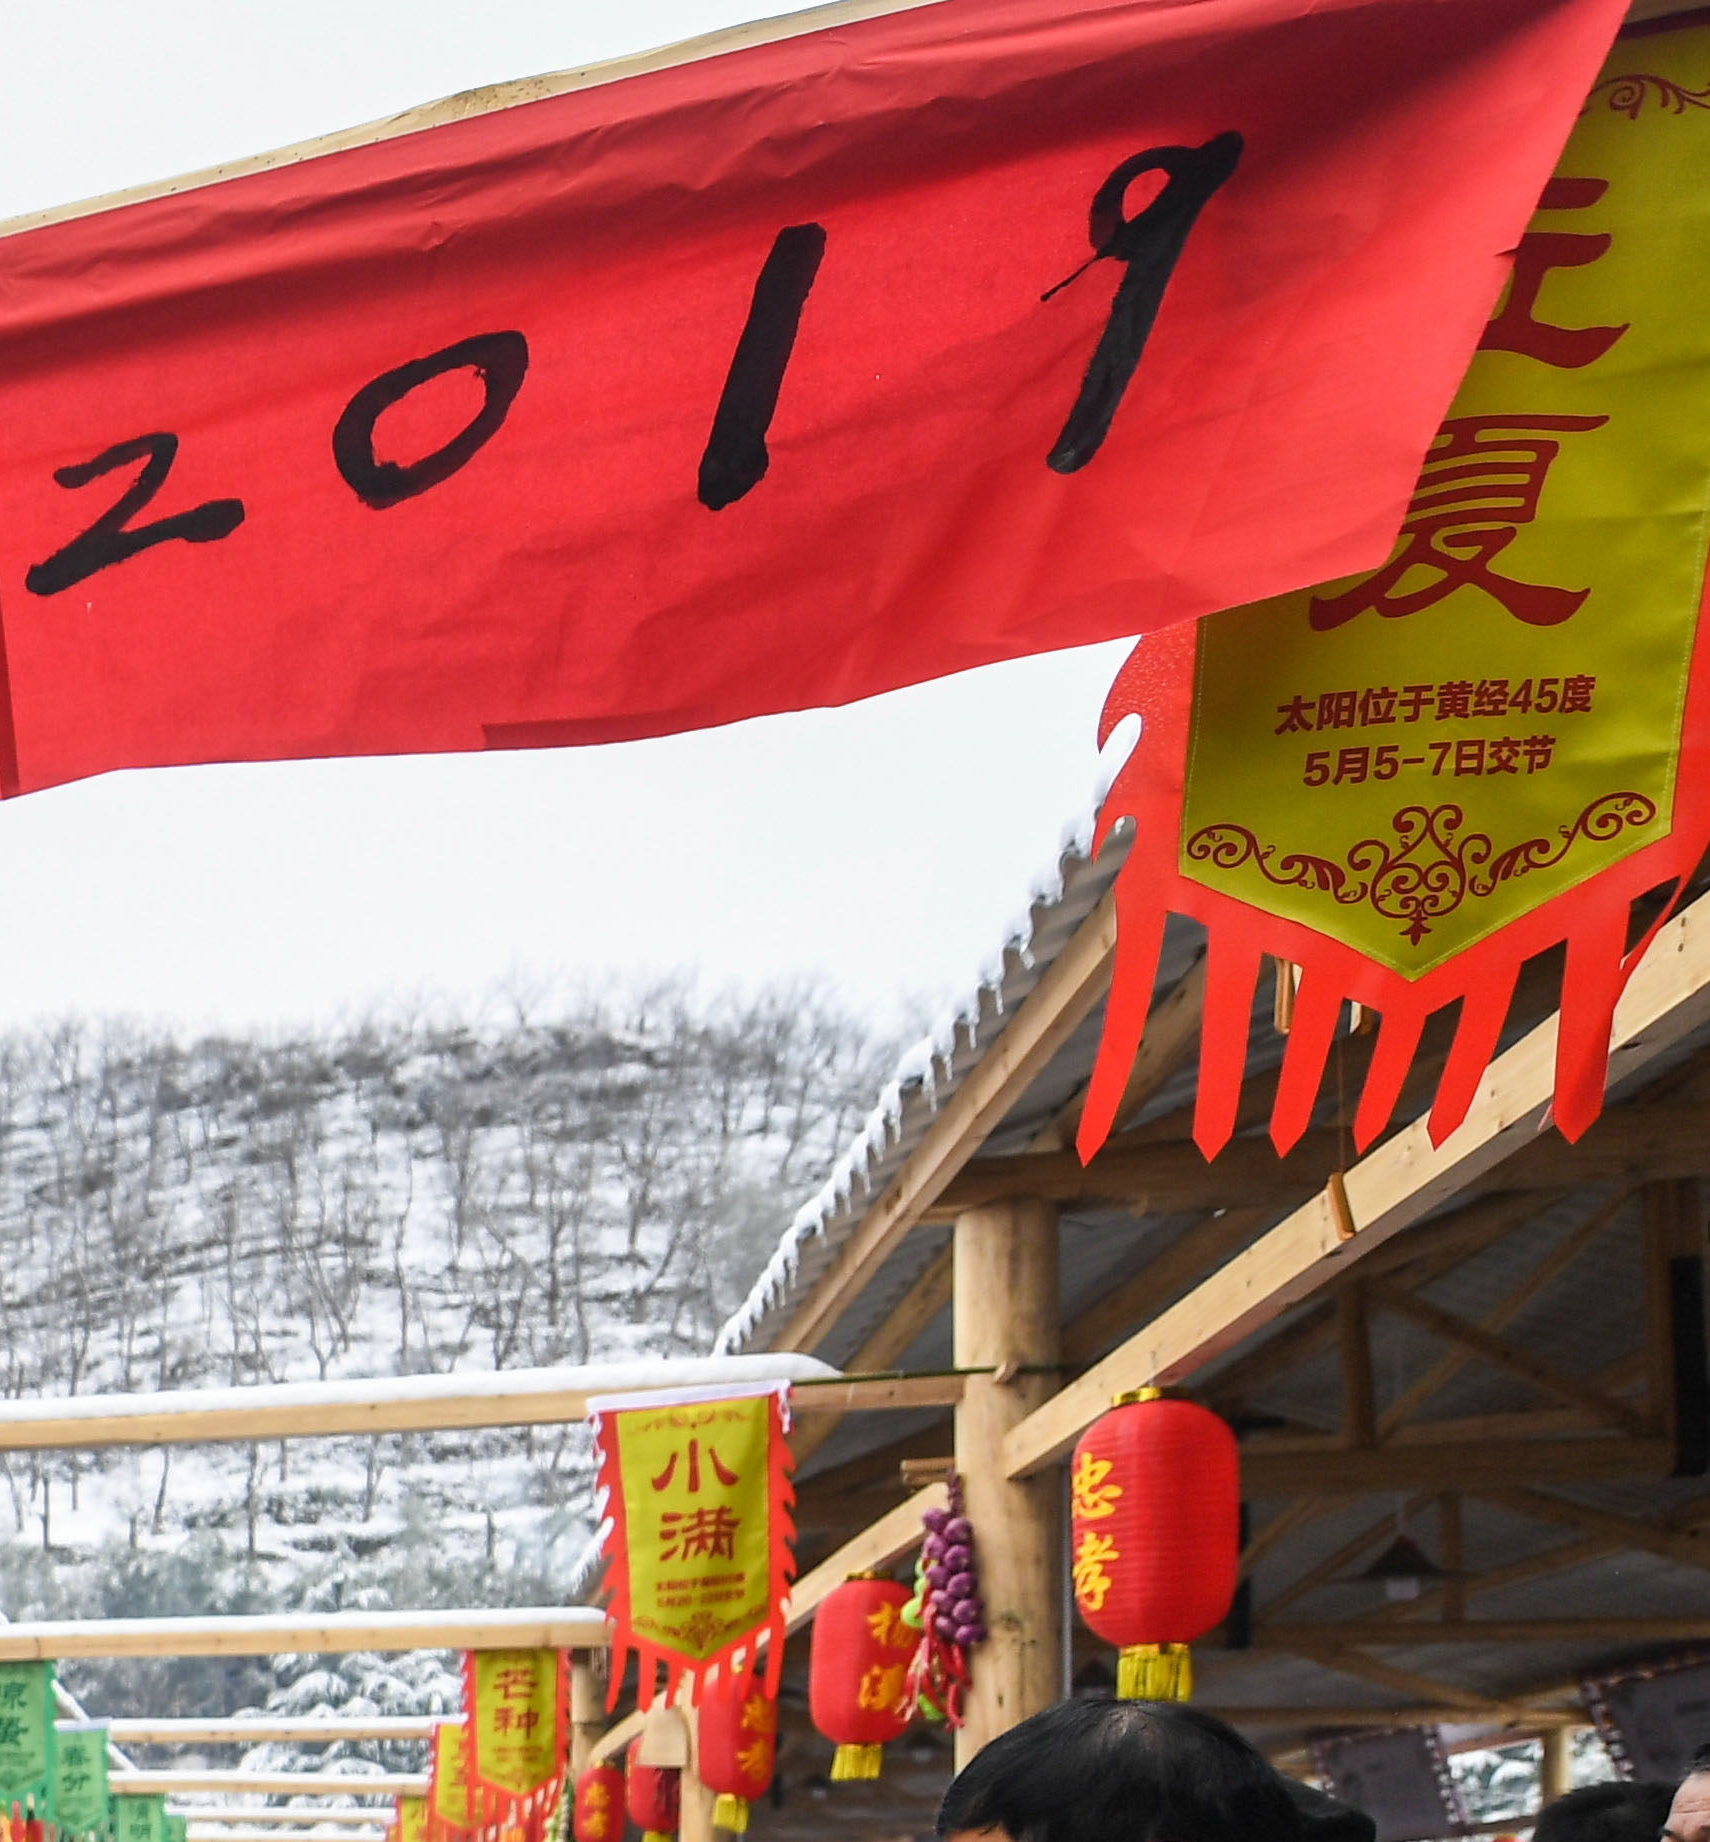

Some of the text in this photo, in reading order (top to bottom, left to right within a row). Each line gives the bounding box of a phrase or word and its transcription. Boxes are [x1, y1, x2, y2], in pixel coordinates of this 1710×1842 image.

[24, 131, 1245, 597] 2019
[1273, 674, 1597, 736] 太阳位于黄经45度
[1303, 735, 1556, 787] 5月5-7日交节
[651, 1438, 741, 1562] 小满
[1072, 1452, 1123, 1611] 忠孝
